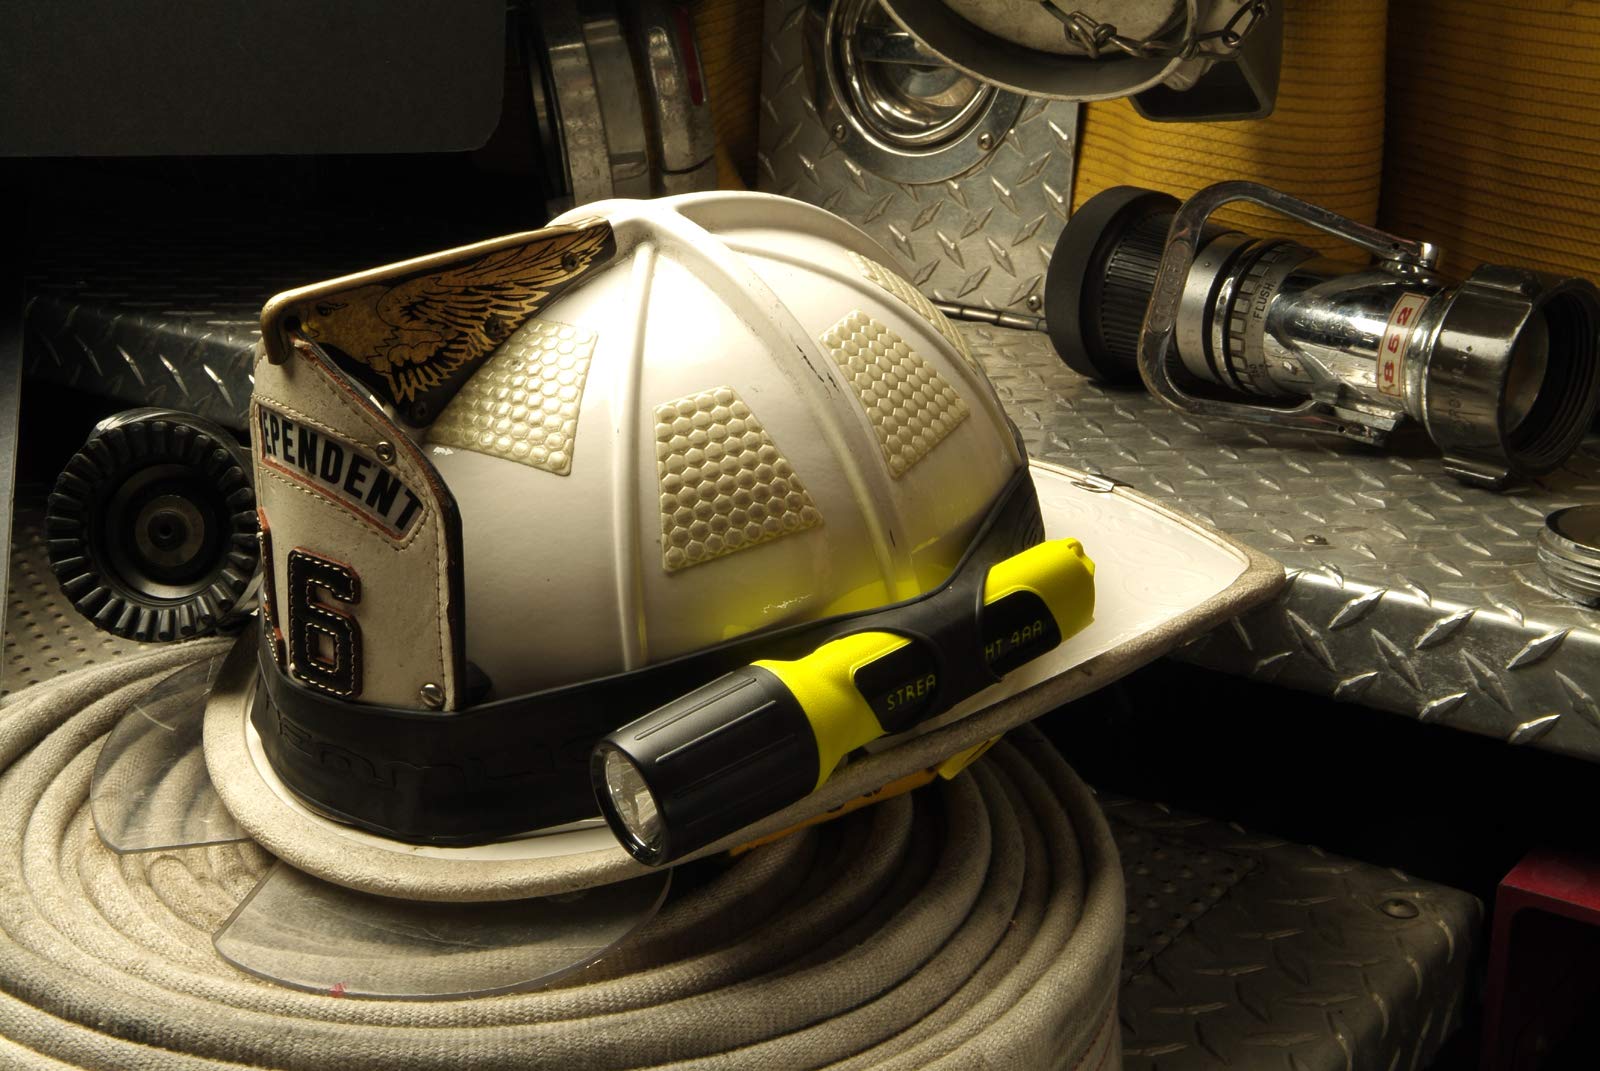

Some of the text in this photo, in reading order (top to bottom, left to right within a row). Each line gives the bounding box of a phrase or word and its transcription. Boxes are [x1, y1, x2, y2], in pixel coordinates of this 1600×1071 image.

[1252, 281, 1276, 320] FLUSH
[287, 547, 364, 698] 6
[1009, 619, 1043, 646] 4AA
